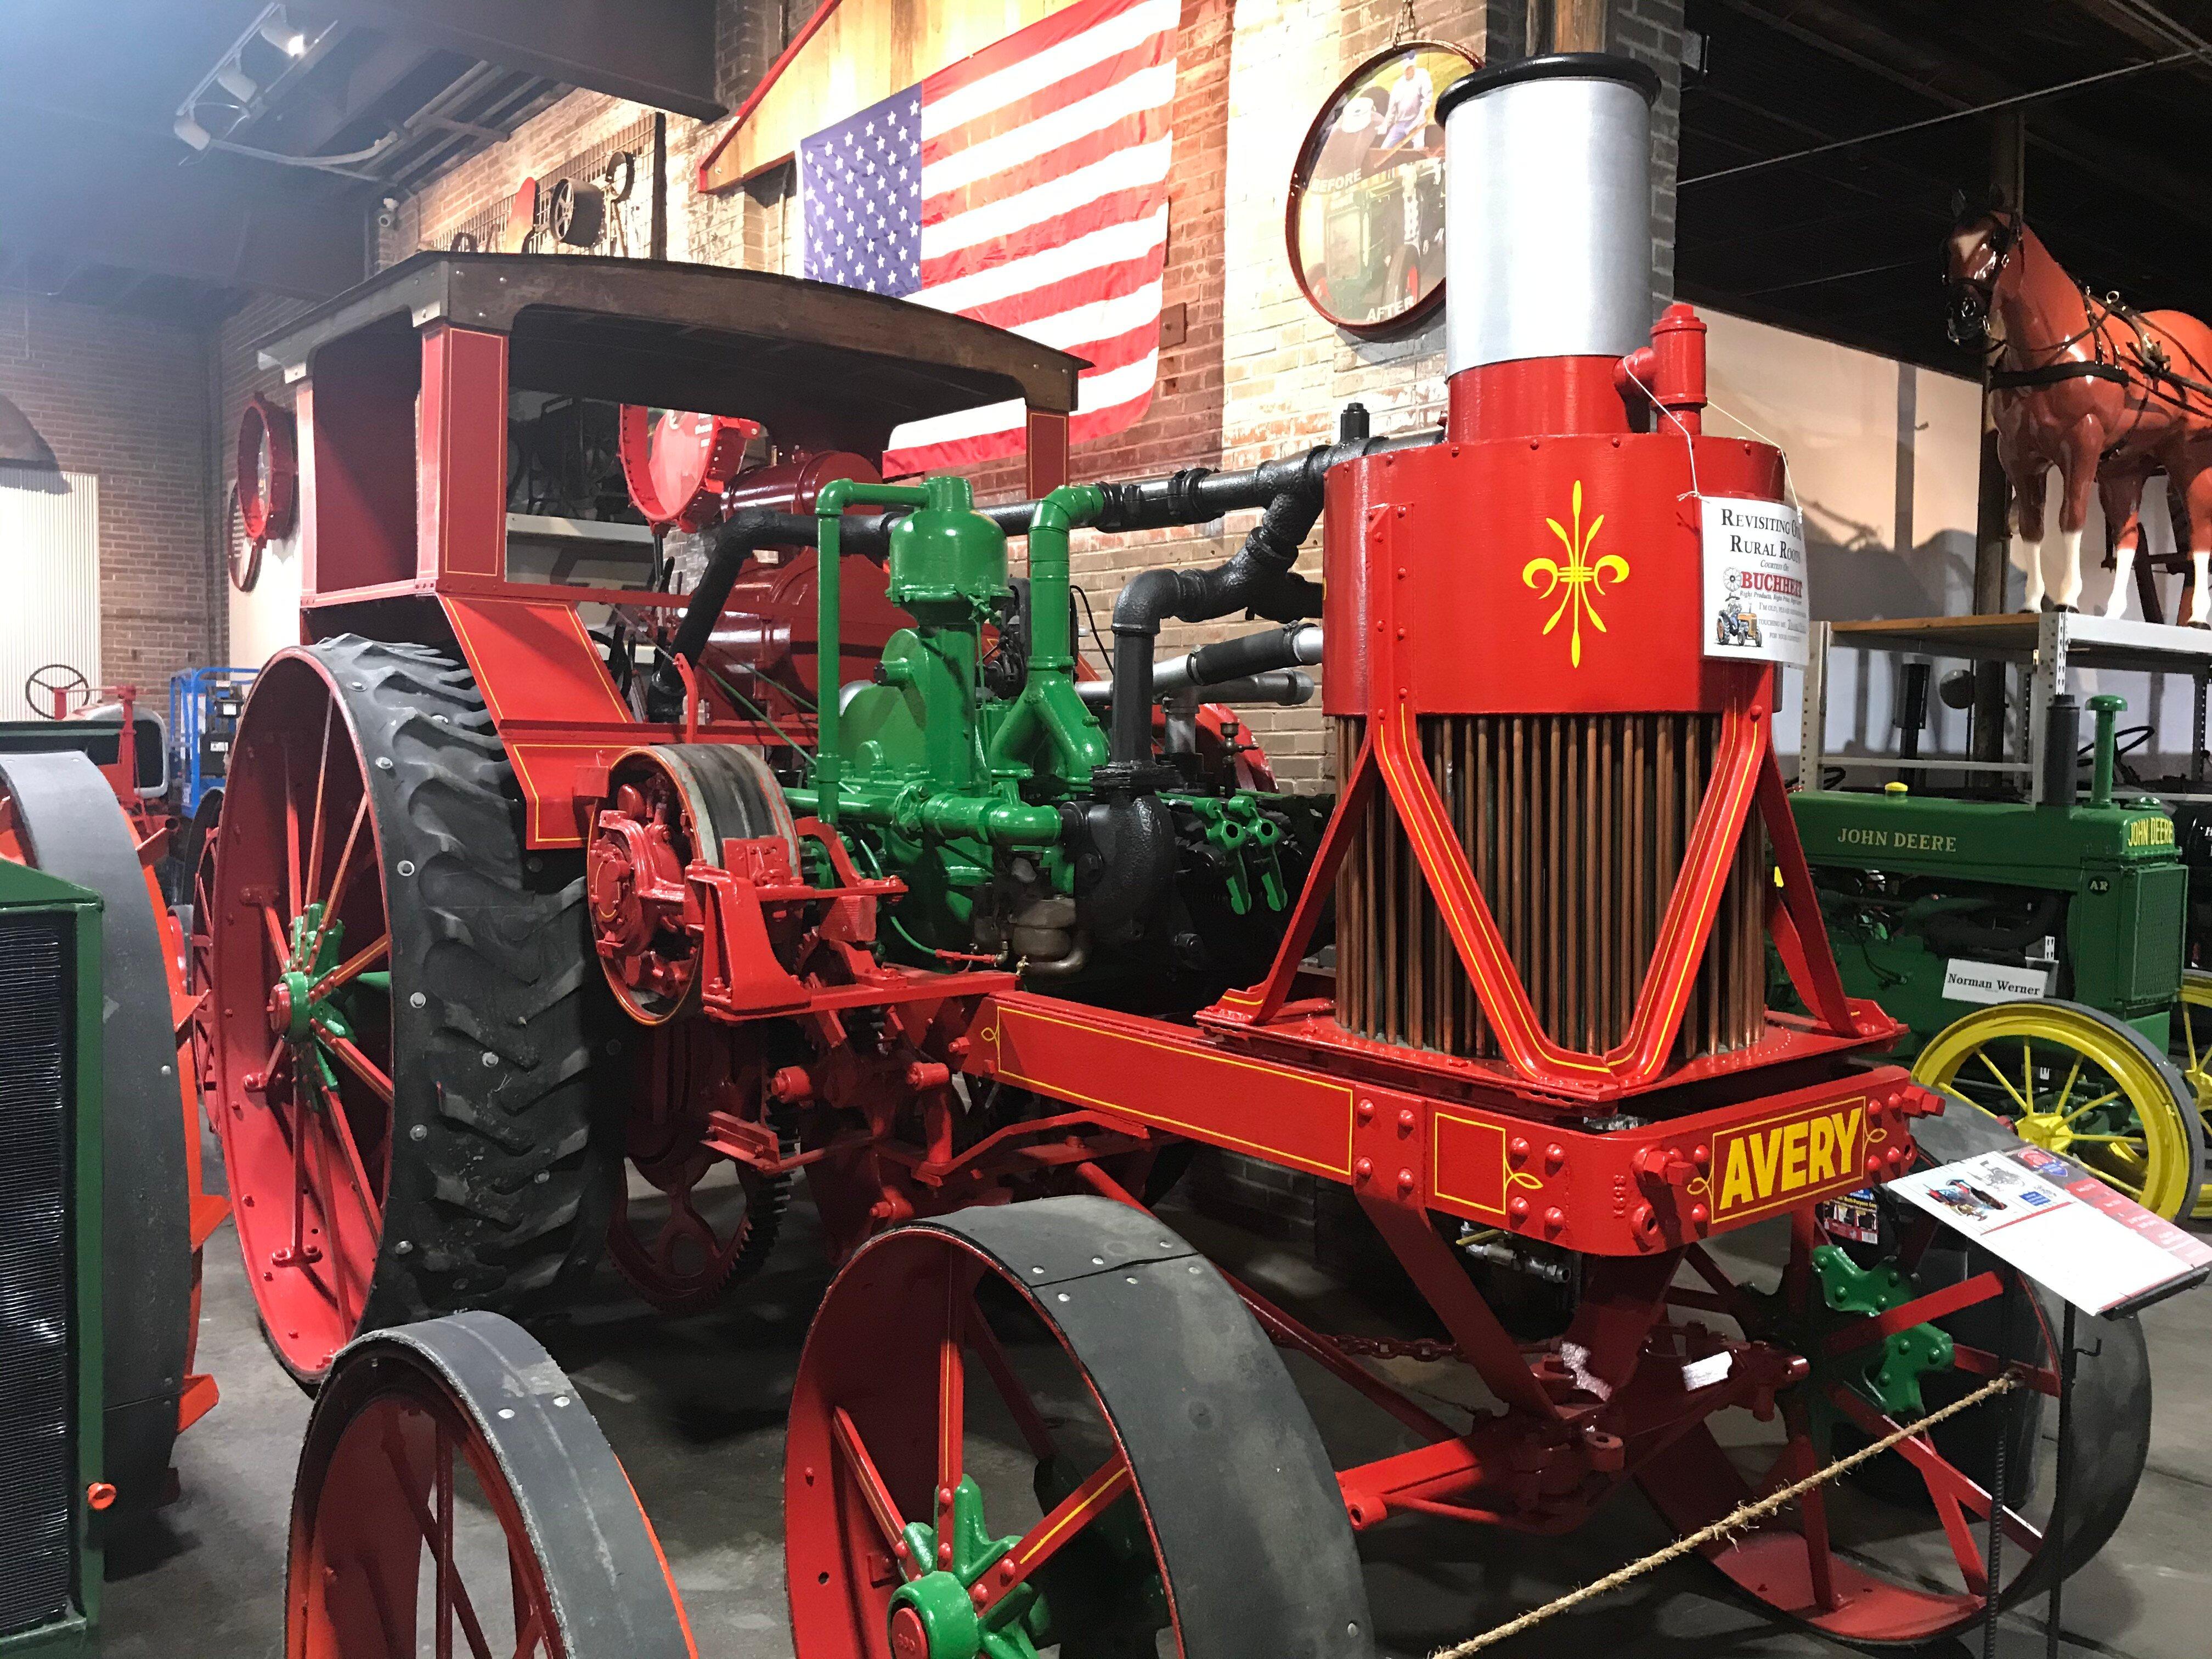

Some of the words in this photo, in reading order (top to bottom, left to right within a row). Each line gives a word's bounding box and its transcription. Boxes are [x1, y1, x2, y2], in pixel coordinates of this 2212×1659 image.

[1312, 168, 1362, 193] BEFORE
[1366, 295, 1414, 322] AFTER
[1720, 508, 1790, 535] REVISITING
[1730, 534, 1776, 557] RURAL
[1838, 828, 1888, 846] JOHN
[1894, 832, 1956, 852] DEERE
[2128, 819, 2148, 847] JOHN
[2151, 816, 2174, 845] DEERE
[1948, 973, 1992, 989] Norman
[1996, 979, 2040, 996] Werner
[1719, 1107, 1863, 1210] AVERY
